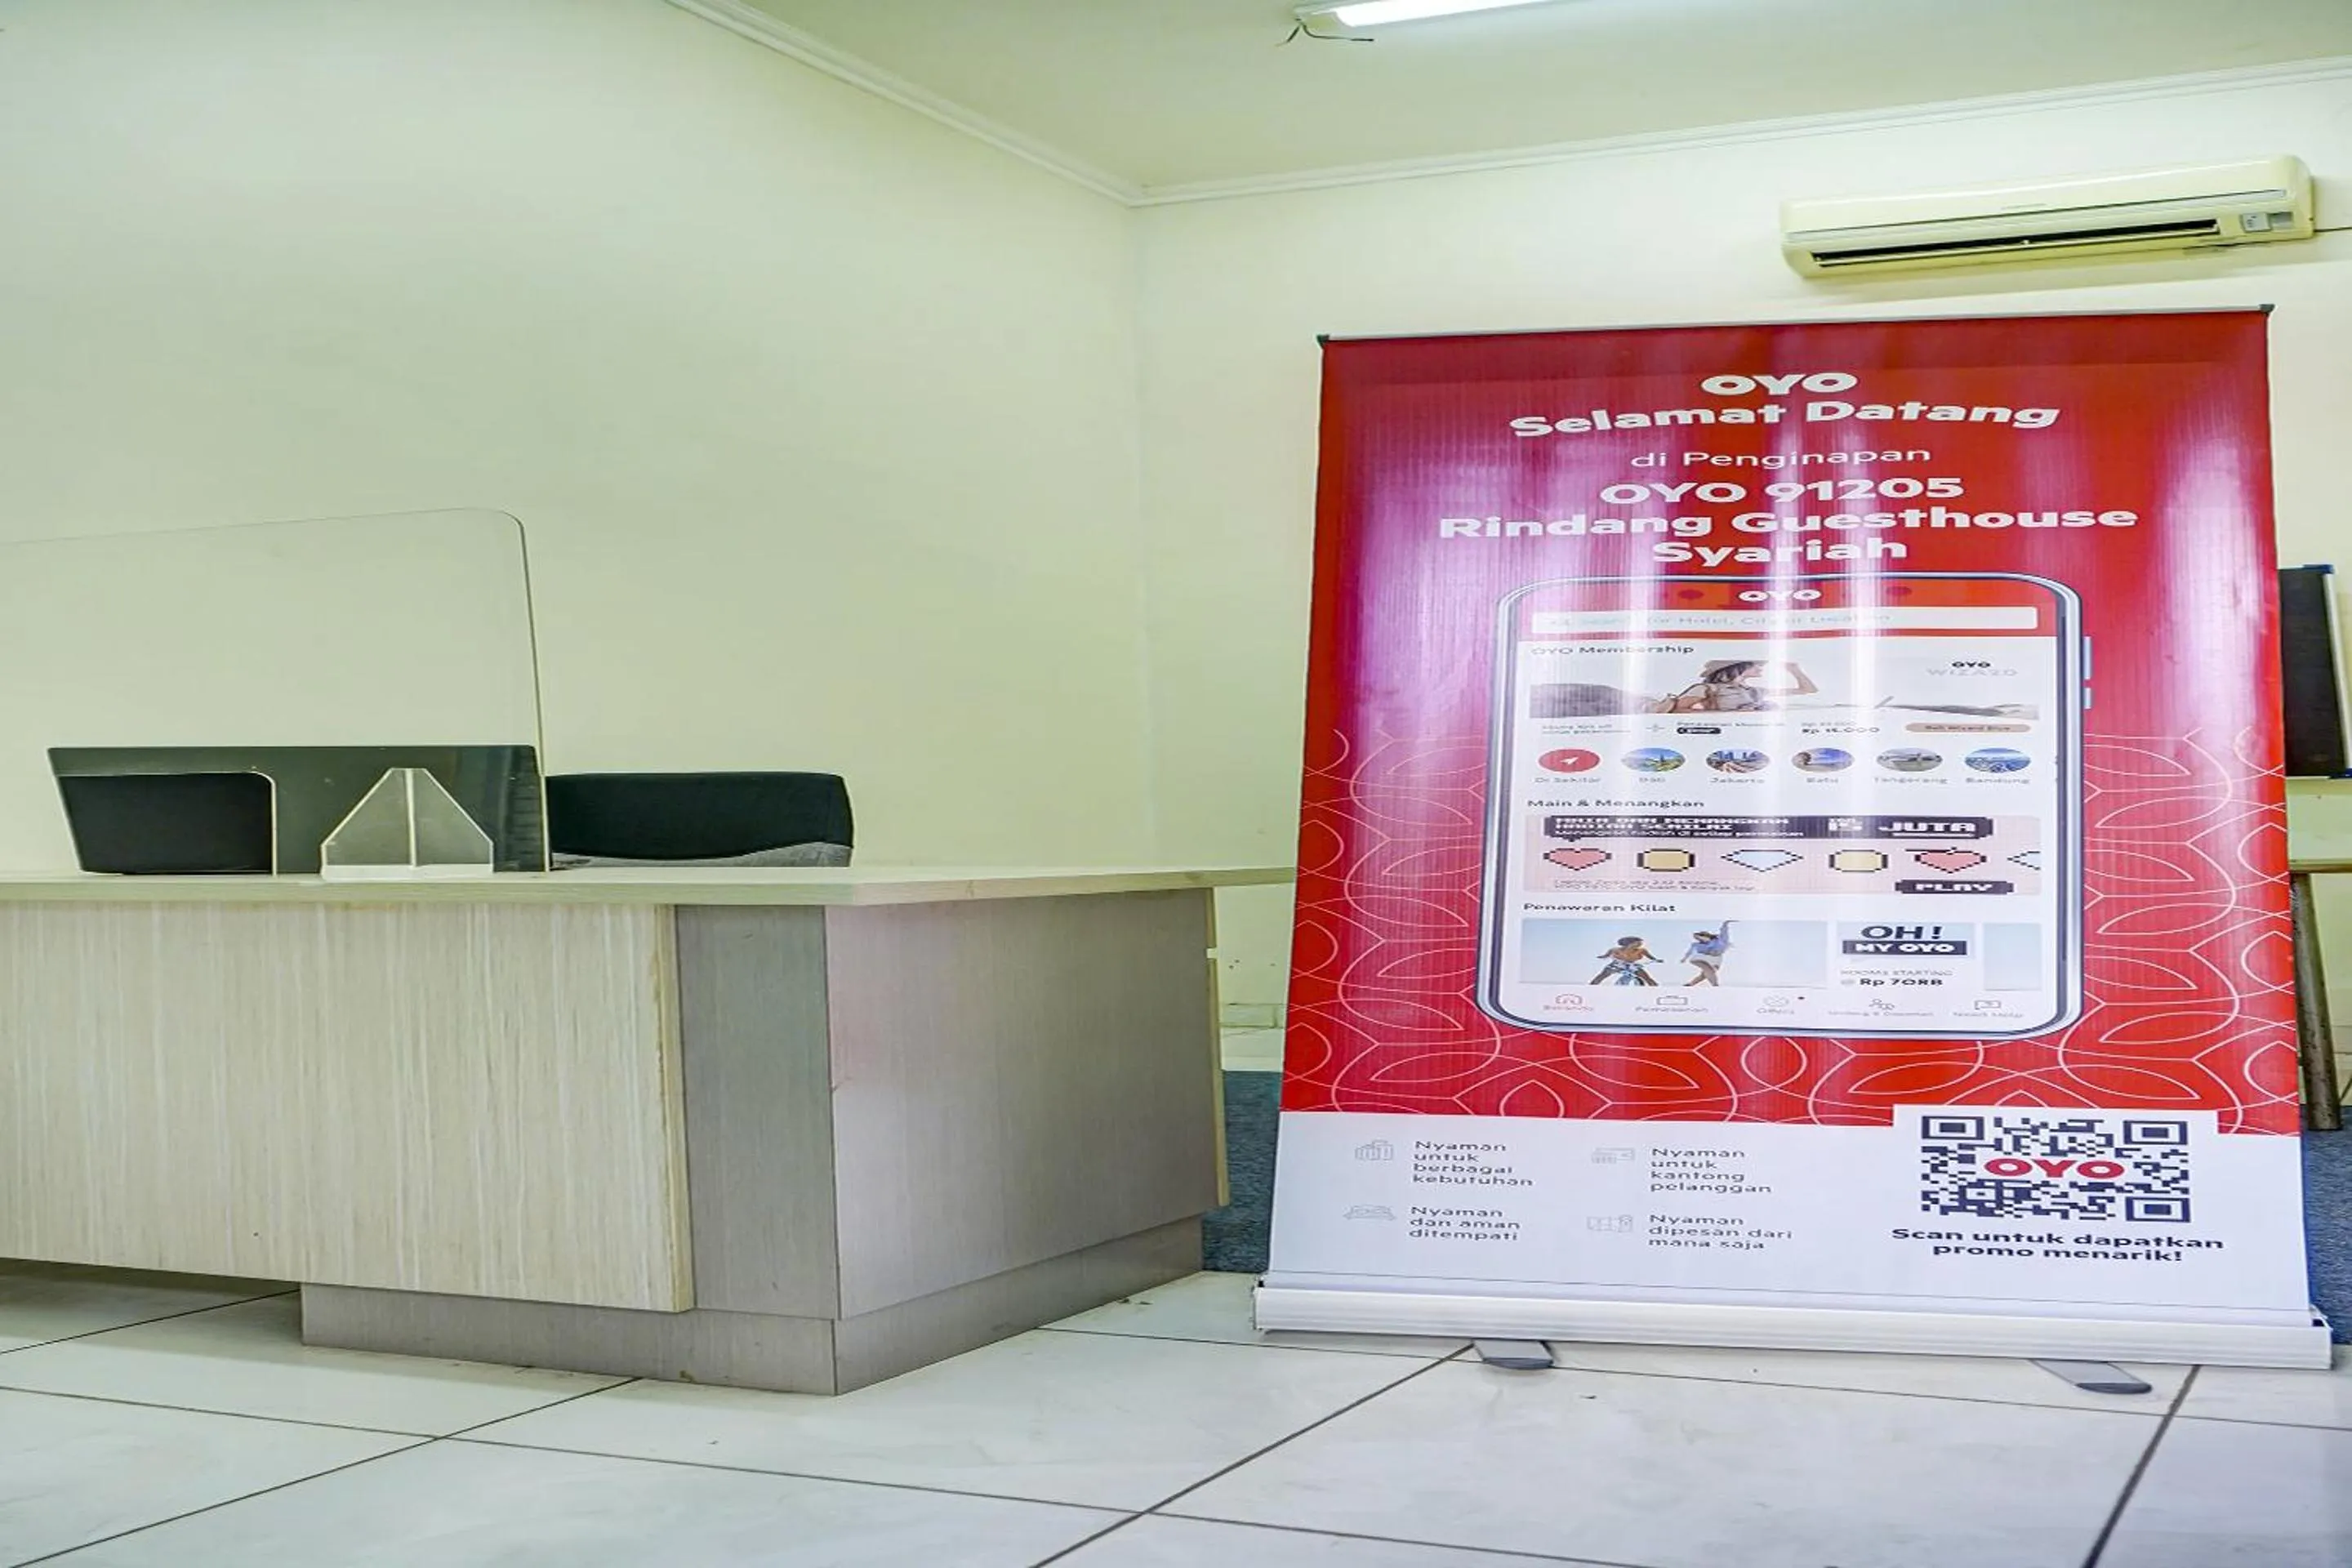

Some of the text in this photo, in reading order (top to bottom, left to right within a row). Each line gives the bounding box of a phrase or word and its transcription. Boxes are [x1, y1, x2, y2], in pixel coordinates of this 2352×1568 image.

[1701, 372, 1858, 396] OYO
[1509, 400, 2060, 437] Selamat Datang
[1631, 446, 1931, 470] di Penginapan
[1600, 476, 1966, 504] OYO 91205
[1439, 506, 2138, 541] Rindang Guesthouse
[1652, 537, 1907, 567] Syariah
[1527, 799, 1704, 809] Main & Menangkan
[1878, 822, 1976, 832] JUTA
[1915, 883, 1993, 891] PLAY
[1524, 903, 1677, 912] Penawaran Kilat
[1855, 942, 1956, 953] MY OYO
[1859, 978, 1885, 987] Rp
[1414, 1141, 1507, 1153] Nyaman
[1414, 1152, 1479, 1162] untuk
[1651, 1148, 1746, 1160] Nyaman
[1413, 1163, 1512, 1175] berbagai
[1650, 1160, 1717, 1169] untuk
[1984, 1157, 2127, 1178] OYO
[1413, 1174, 1533, 1186] kebutuhan
[1650, 1170, 1746, 1182] kantong
[1650, 1182, 1772, 1194] pelanggan
[1410, 1205, 1503, 1218] Nyaman
[1410, 1217, 1521, 1230] dan aman
[1650, 1214, 1744, 1227] Nyaman
[1409, 1229, 1518, 1241] ditempati
[1649, 1225, 1793, 1239] dipesan dari
[1648, 1239, 1765, 1250] mana saja
[1891, 1227, 2225, 1250] Scan untuk dapatkan
[1932, 1244, 2184, 1262] promo menarik!
